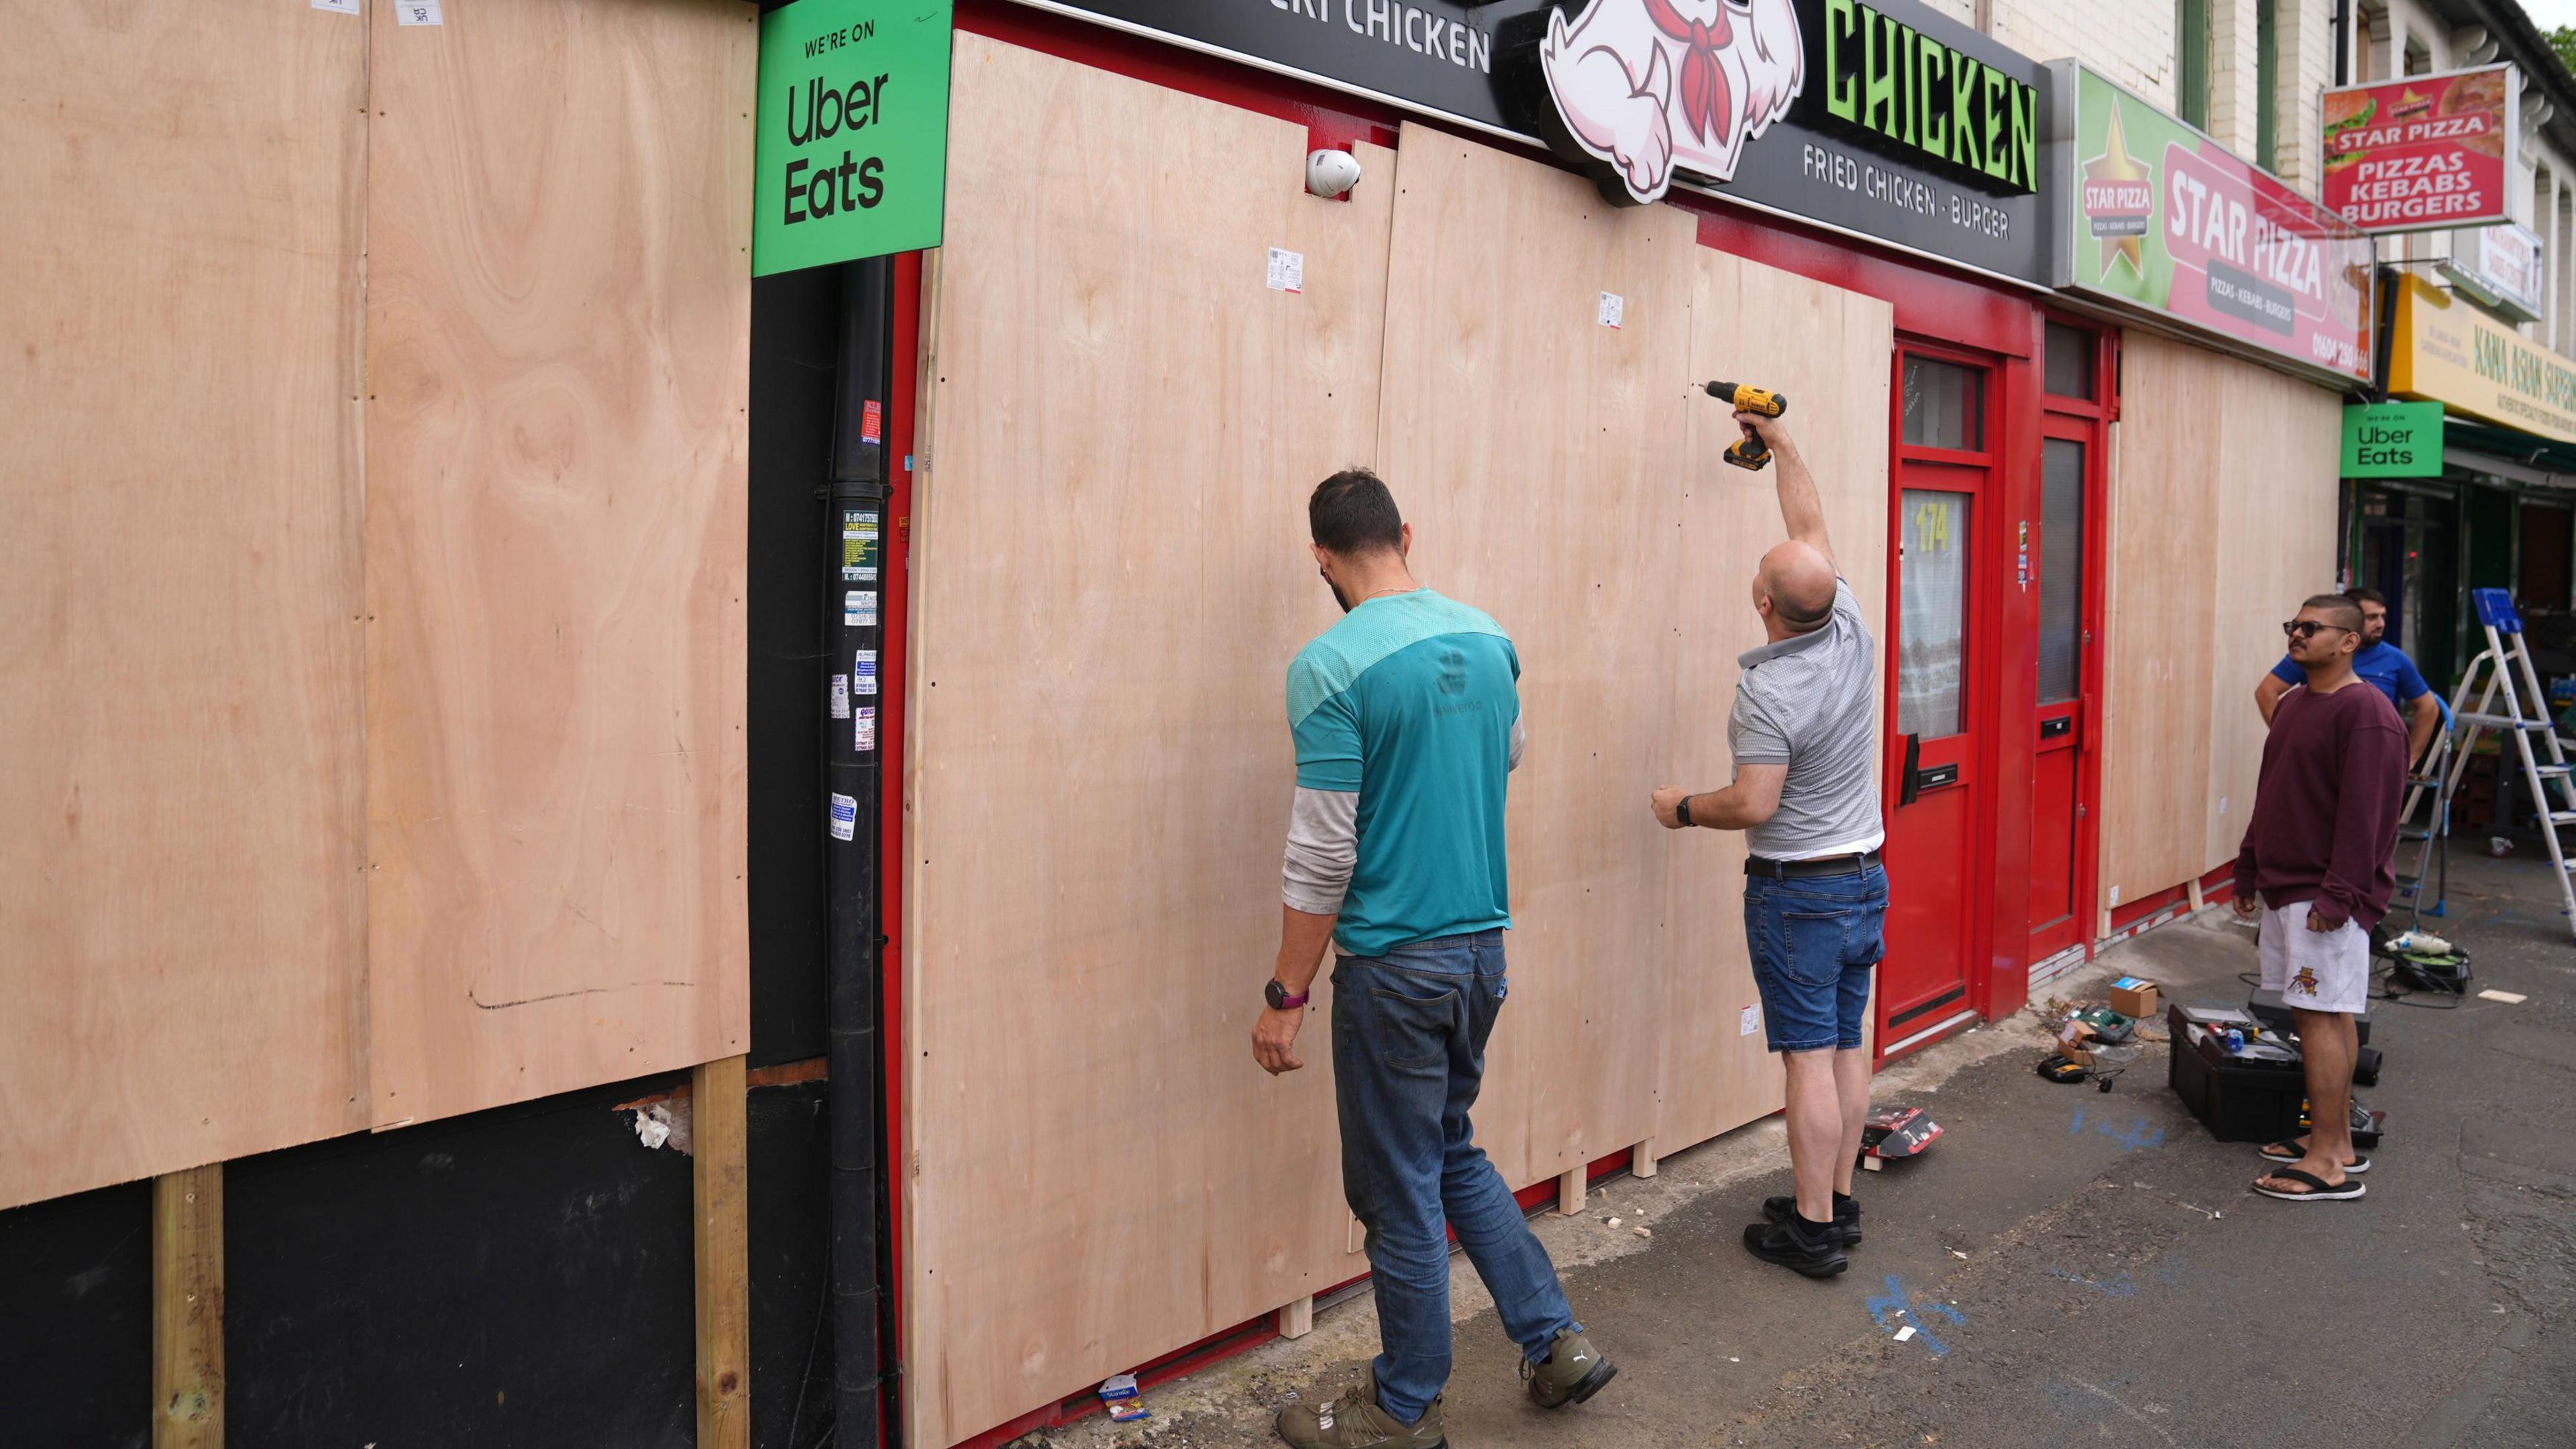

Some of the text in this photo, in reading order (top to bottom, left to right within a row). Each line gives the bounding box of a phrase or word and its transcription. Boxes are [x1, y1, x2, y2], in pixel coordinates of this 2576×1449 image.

[851, 19, 875, 43] ON
[1344, 0, 1491, 75] CHICKEN
[788, 73, 889, 146] Uber
[1825, 0, 2038, 193] CHICKEN
[2339, 116, 2485, 151] STAR PIZZA
[2357, 151, 2464, 182] PIZZAS
[784, 150, 884, 225] Eats
[1803, 144, 2010, 241] FRIED CHICKEN BURGER
[2086, 186, 2151, 210] STAR PIZZA
[2350, 171, 2471, 203] KEBABS
[2340, 191, 2482, 223] BURGERS
[2171, 169, 2322, 301] STAR PIZZA
[2211, 276, 2235, 299] PIZZAS
[2359, 427, 2413, 445] Uber
[2358, 447, 2413, 466] Eats
